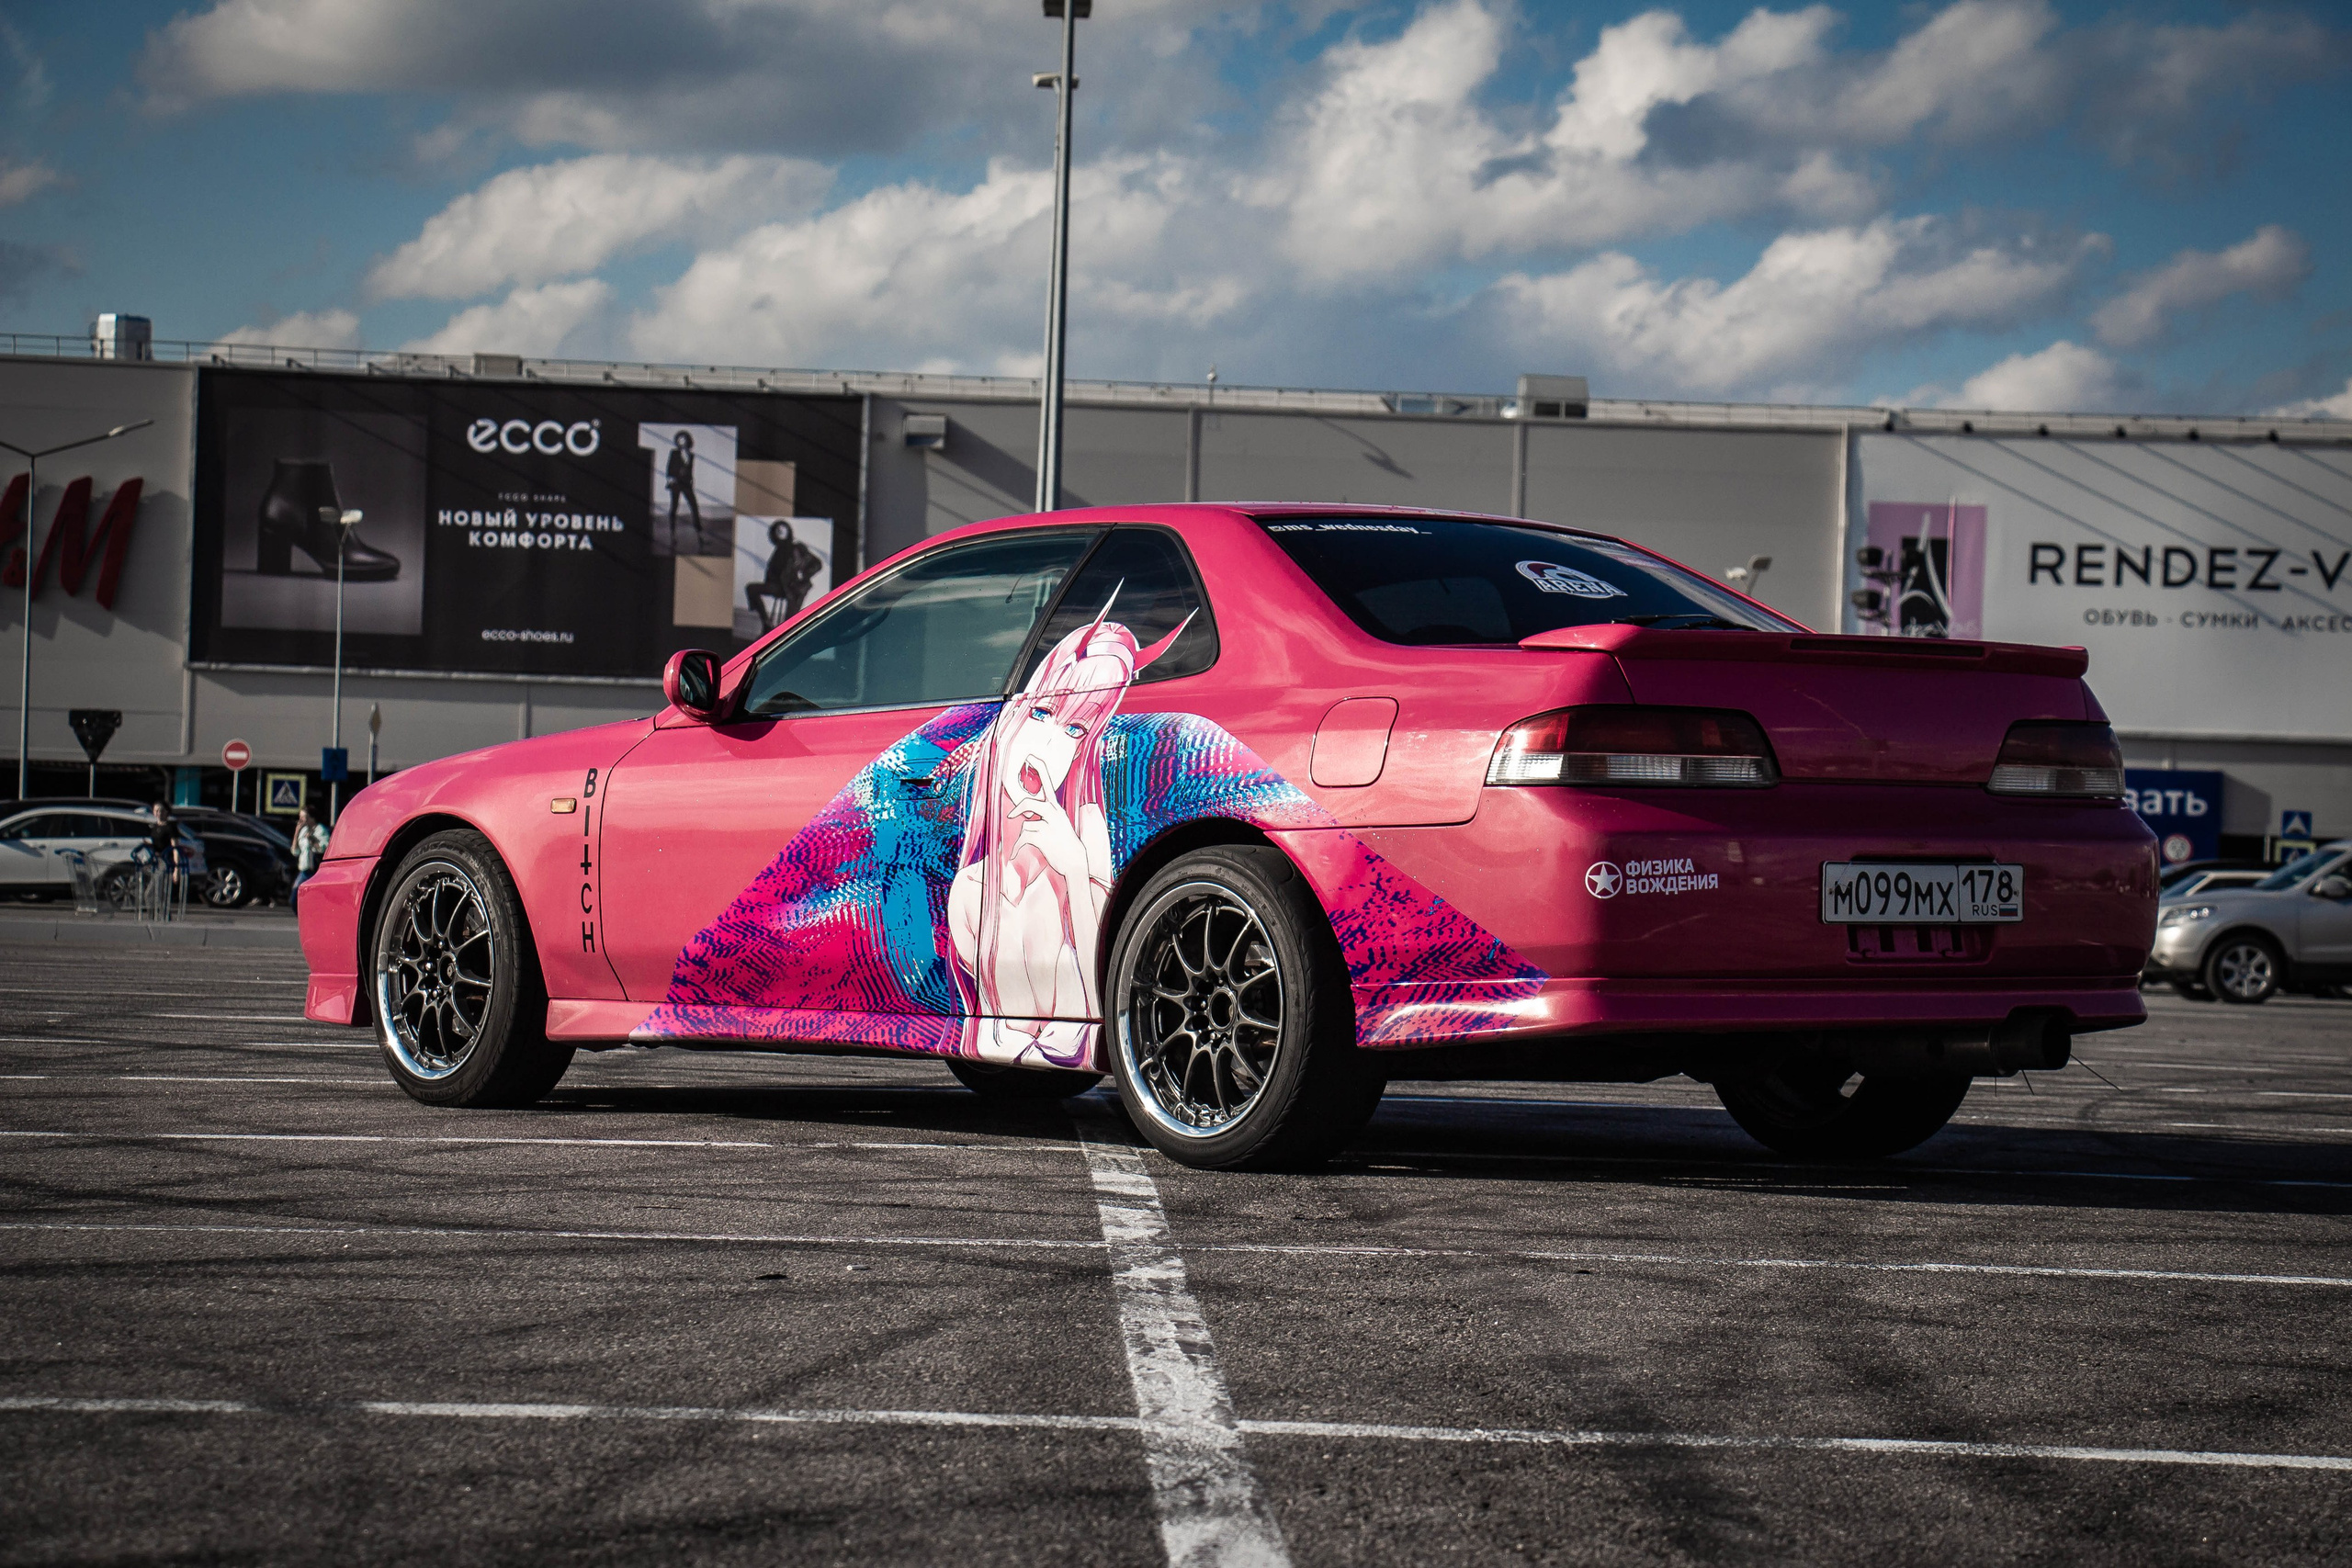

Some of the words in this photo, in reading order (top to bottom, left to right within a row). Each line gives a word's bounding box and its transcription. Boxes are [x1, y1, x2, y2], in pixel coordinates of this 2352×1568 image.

[467, 418, 600, 457] ecco
[437, 508, 517, 528] НОВЫЙ
[525, 512, 625, 533] УРОВЕНЬ
[468, 530, 594, 551] КОМФОРТА
[2027, 542, 2352, 592] RENDEZ-V
[1535, 578, 1620, 595] ARENA
[2083, 607, 2159, 628] ОБУВЬ
[2178, 610, 2260, 630] СУМКИ
[481, 629, 574, 644] ecco-shoes.ru
[1625, 858, 1695, 877] ФИЗИКА
[1626, 874, 1719, 896] ВОЖДЕНИЯ
[1962, 870, 2013, 903] 178
[1972, 904, 1998, 917] RUS
